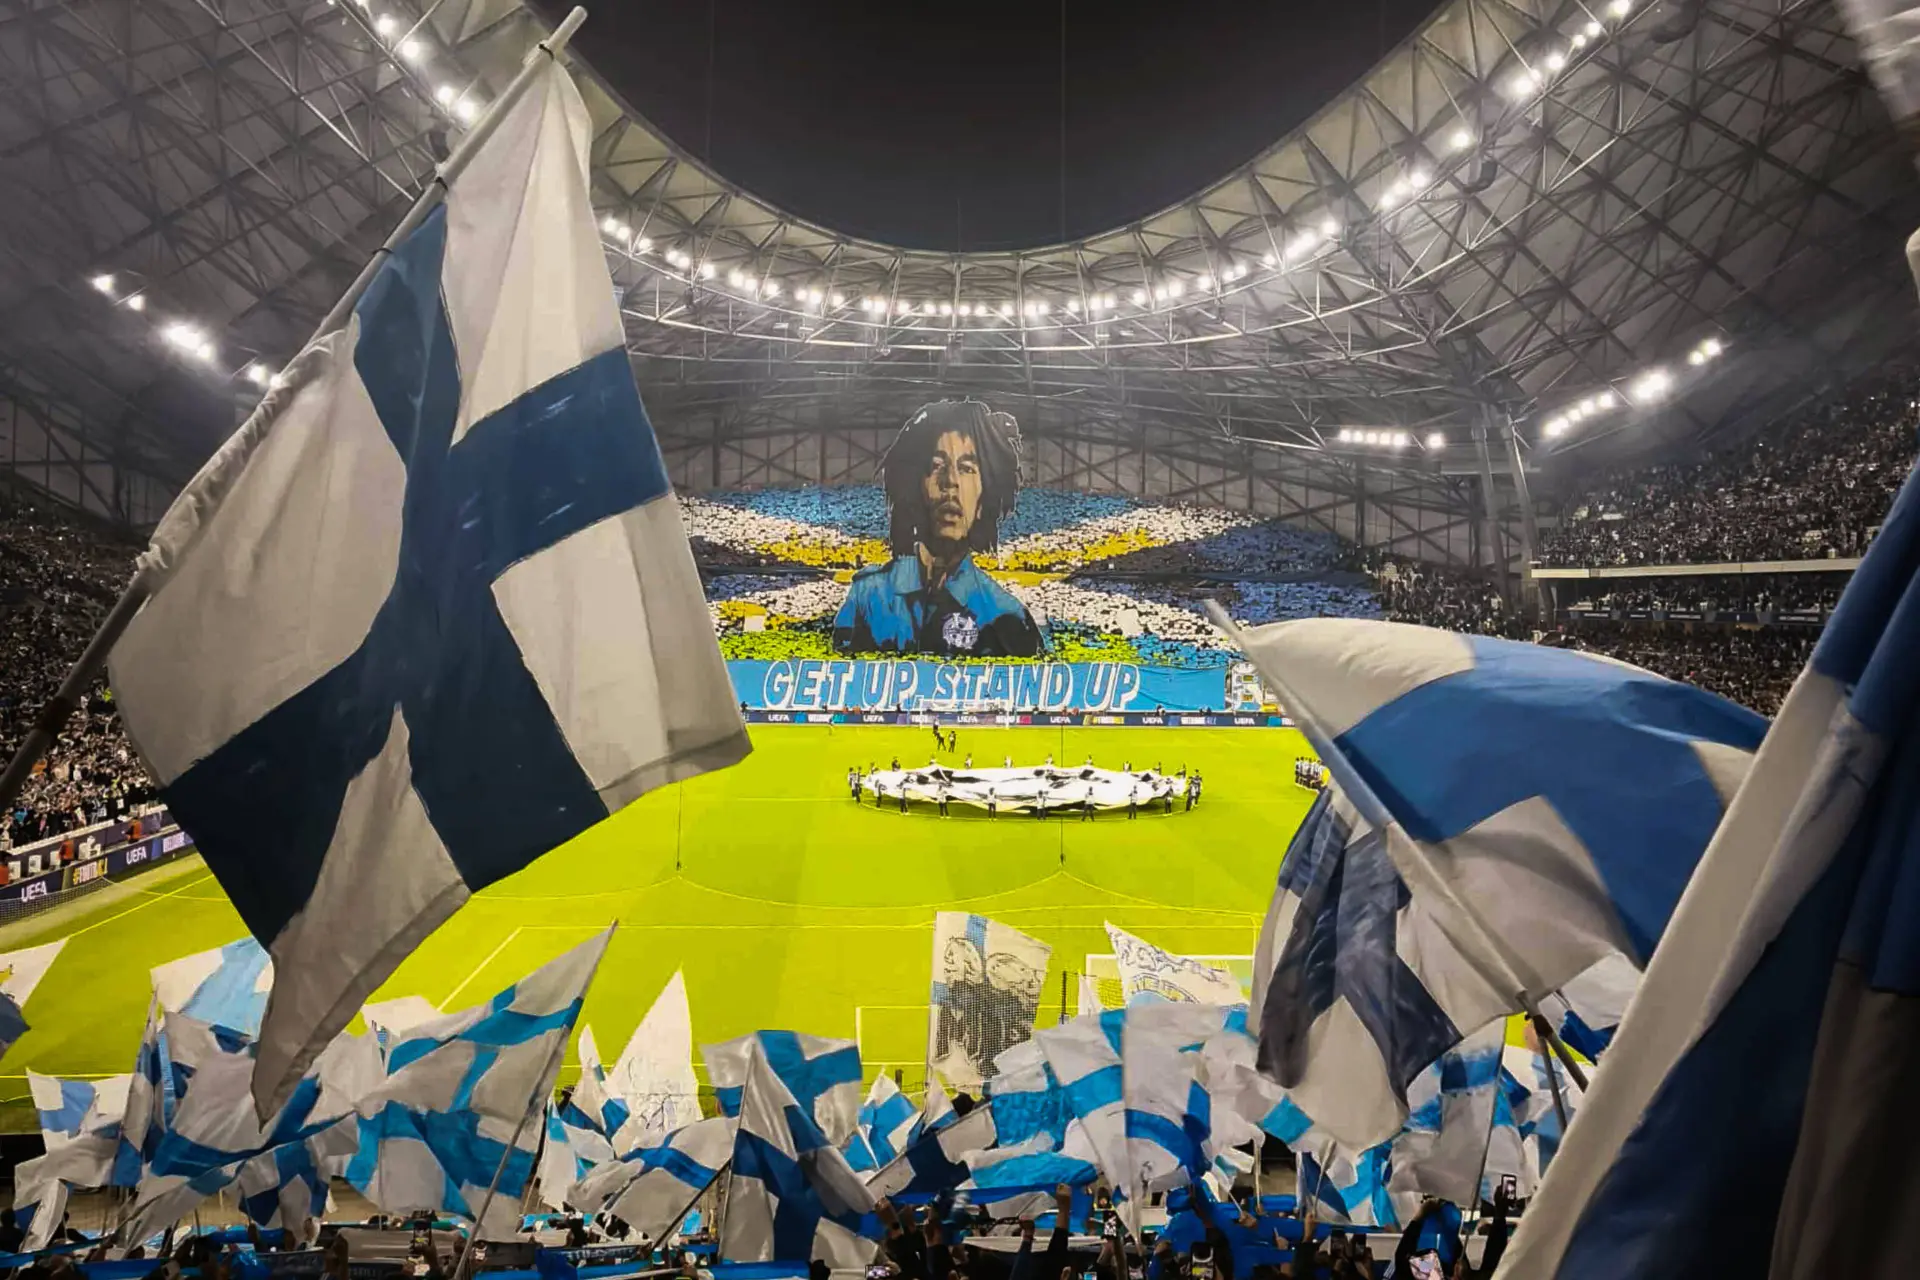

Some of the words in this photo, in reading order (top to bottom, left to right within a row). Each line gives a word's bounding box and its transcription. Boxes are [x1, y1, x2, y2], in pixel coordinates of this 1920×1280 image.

[763, 660, 854, 709] GET
[932, 662, 1074, 712] STAND
[1084, 661, 1140, 712] UP
[767, 713, 790, 722] UEFA
[863, 714, 885, 723] UEFA
[957, 715, 978, 723] UEFA
[1050, 716, 1071, 724] UEFA
[1142, 716, 1164, 725] UEFA
[1234, 717, 1255, 725] UEFA
[126, 846, 147, 865] UEFA
[21, 880, 48, 902] UEFA
